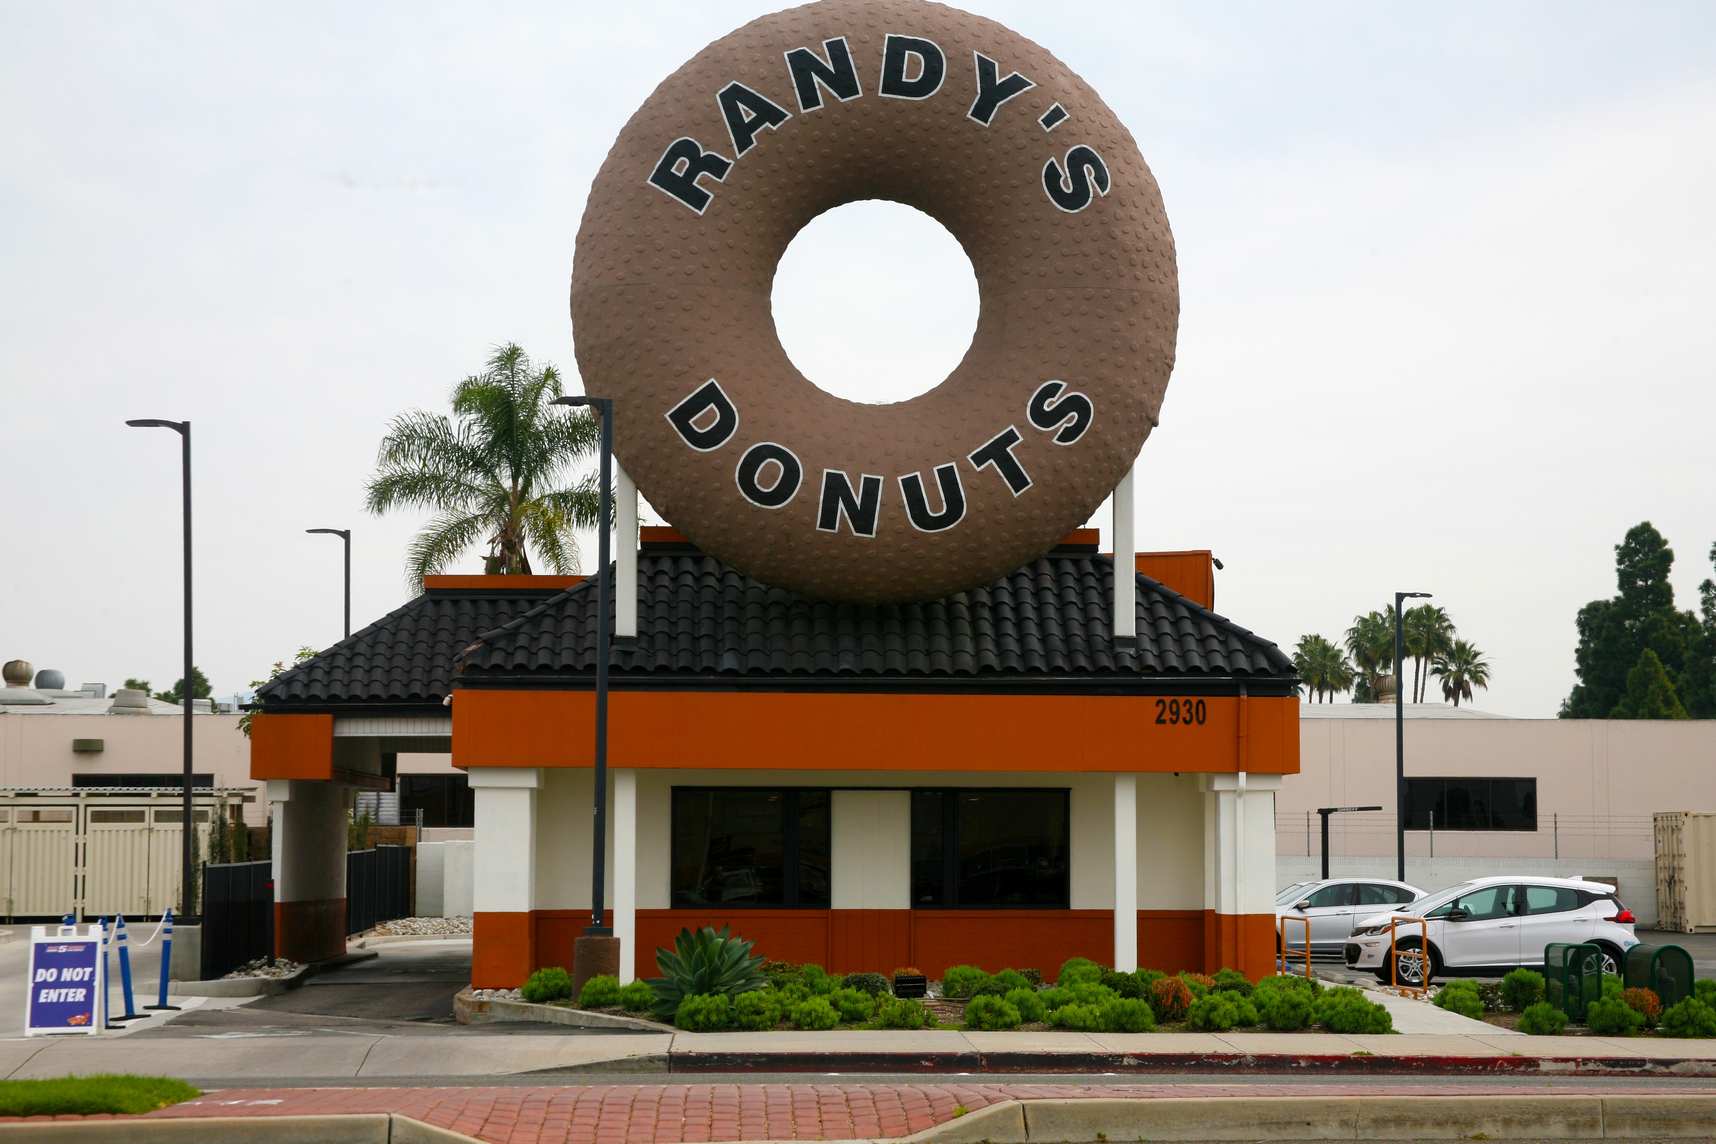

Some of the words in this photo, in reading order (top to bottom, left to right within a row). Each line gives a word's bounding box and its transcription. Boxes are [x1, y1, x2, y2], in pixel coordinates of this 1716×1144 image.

[647, 33, 1111, 215] RANDY'S
[664, 378, 1094, 538] DONUTS
[1155, 699, 1206, 725] 2930
[34, 968, 58, 982] DO
[60, 967, 93, 981] NOT
[38, 988, 87, 1003] ENTER
